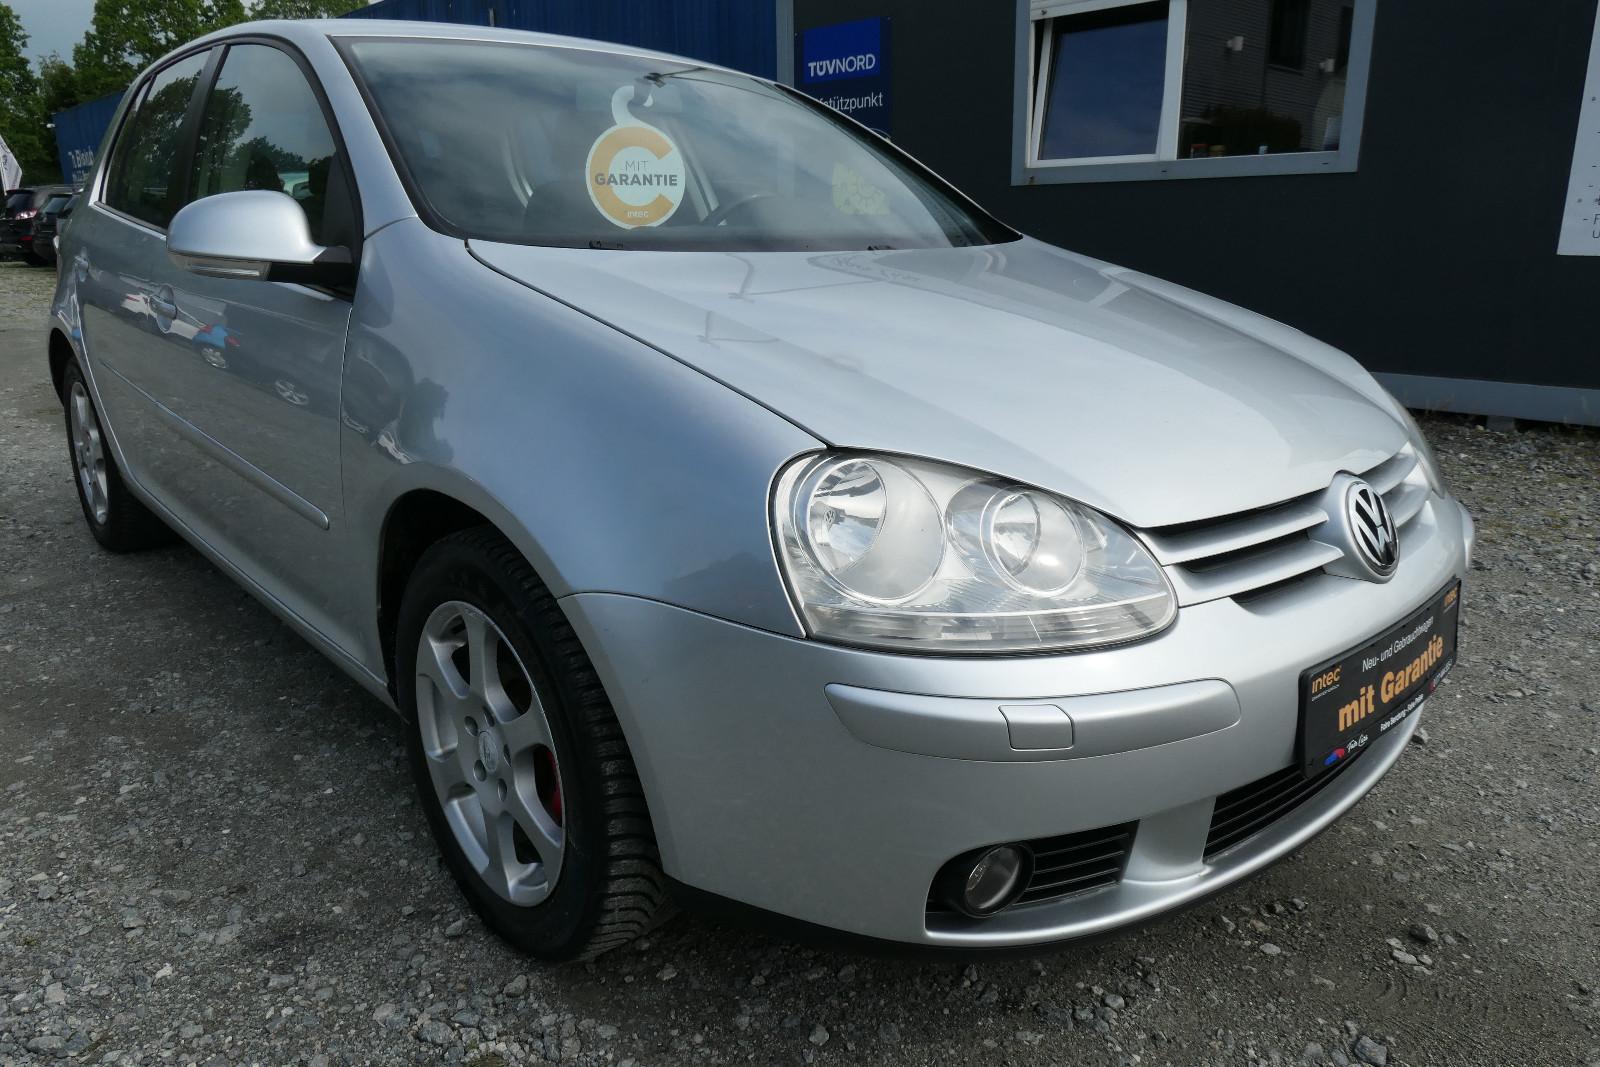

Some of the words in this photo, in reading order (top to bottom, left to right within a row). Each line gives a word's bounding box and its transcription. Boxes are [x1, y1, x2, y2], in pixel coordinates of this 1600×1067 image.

[594, 172, 678, 186] GARANTIE
[625, 160, 648, 171] MIT
[1362, 656, 1379, 672] Neu-
[1380, 644, 1393, 661] und
[1311, 667, 1341, 694] intec
[1338, 685, 1375, 732] mit
[1380, 633, 1443, 703] Garantie
